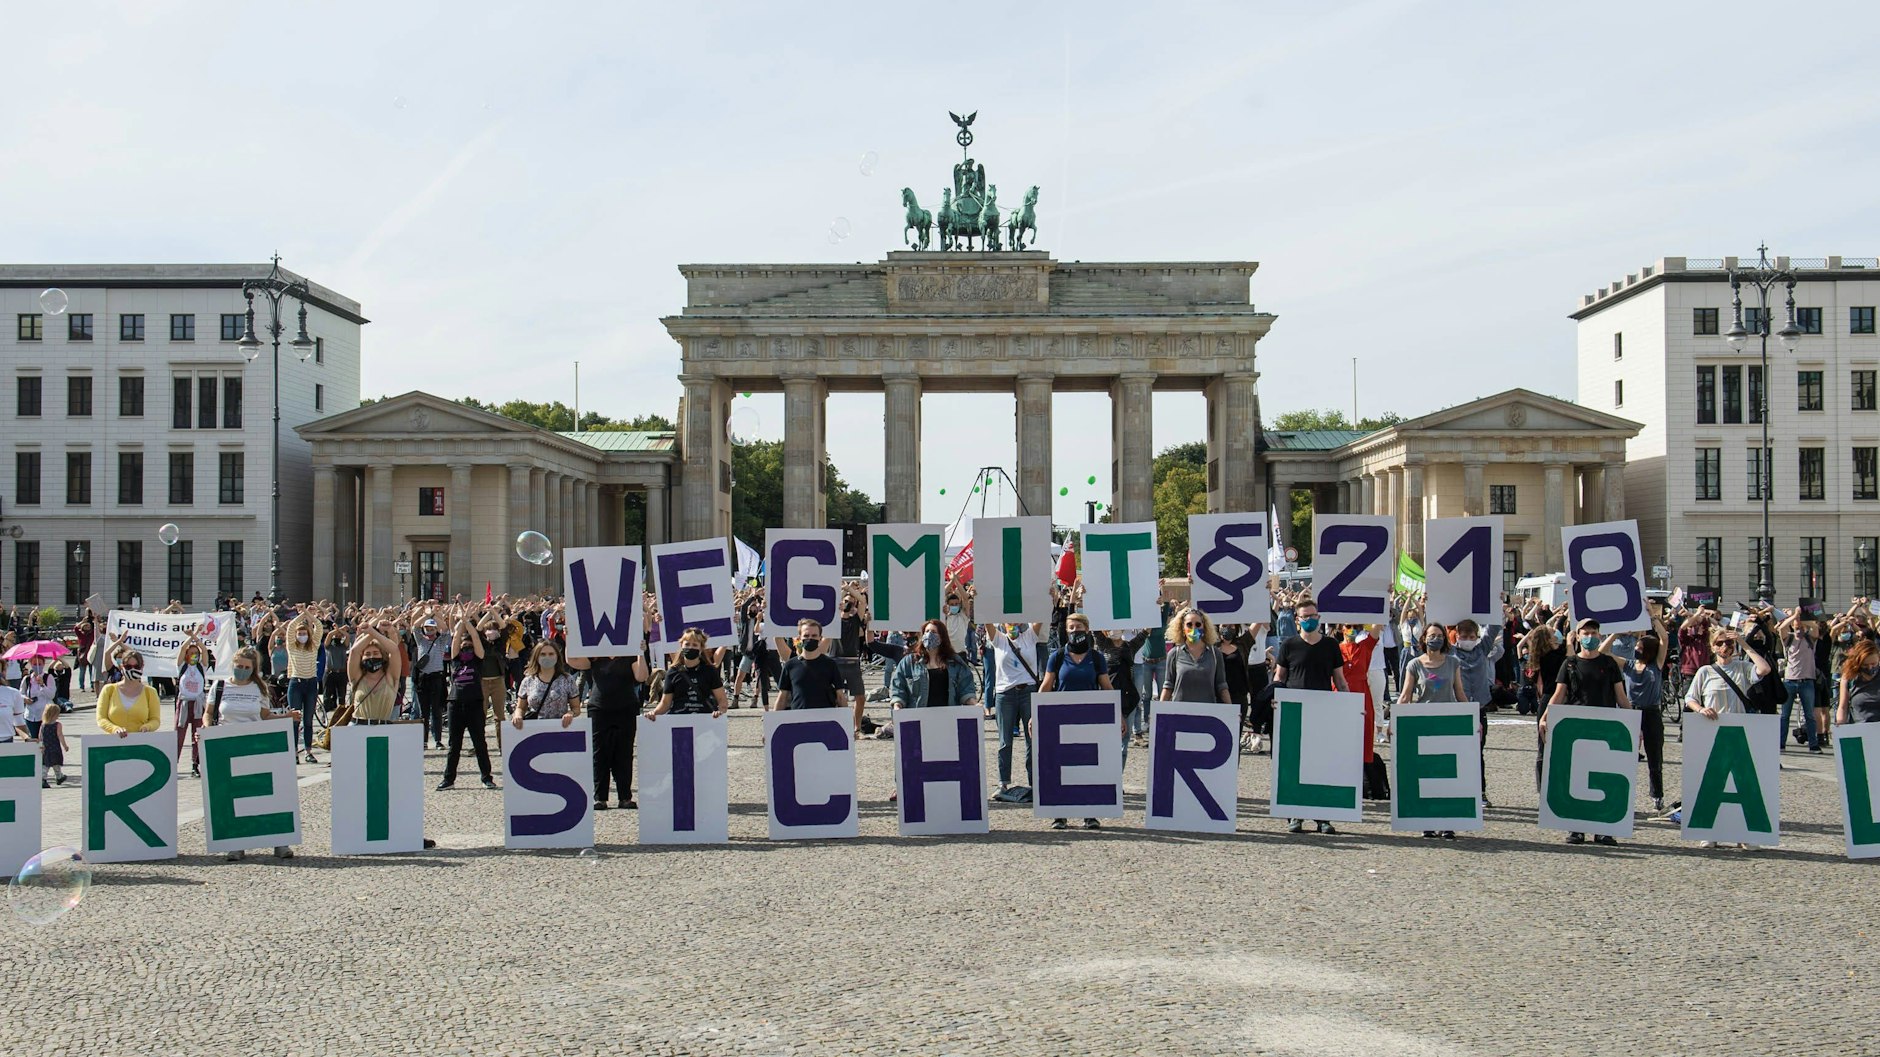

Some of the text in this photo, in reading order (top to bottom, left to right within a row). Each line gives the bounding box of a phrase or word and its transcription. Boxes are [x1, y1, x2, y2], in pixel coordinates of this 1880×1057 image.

[570, 540, 836, 646] WEG
[873, 528, 1153, 620] MIT
[117, 634, 217, 649] Mülldepie
[118, 618, 197, 632] Fundis auf
[508, 703, 1233, 836] SICHER
[1277, 702, 1880, 846] LEGAL
